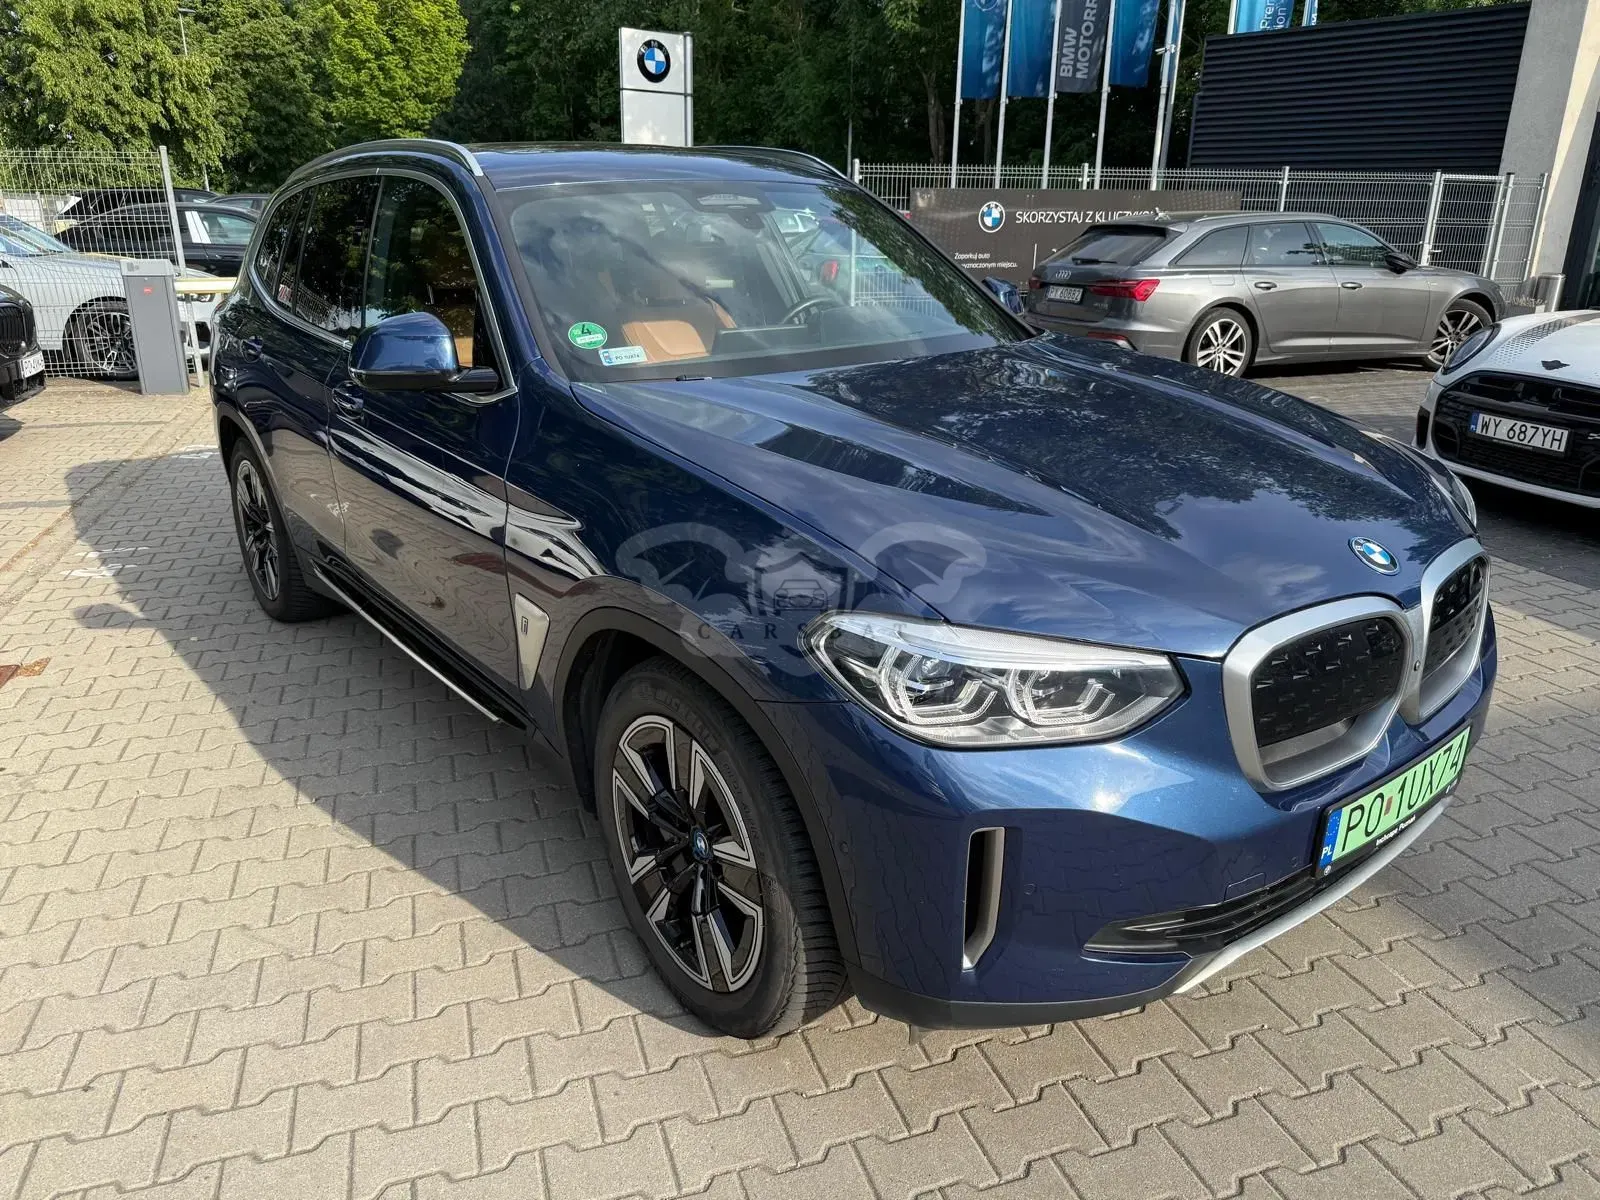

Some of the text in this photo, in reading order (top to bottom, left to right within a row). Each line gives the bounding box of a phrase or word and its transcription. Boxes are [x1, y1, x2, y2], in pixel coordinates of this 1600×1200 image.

[1060, 28, 1077, 77] BMW
[1015, 211, 1083, 224] SKORZYSTAJ
[1085, 211, 1094, 223] Z
[581, 324, 592, 335] 4
[1481, 416, 1502, 437] WY
[1506, 422, 1564, 450] 687YH
[1321, 734, 1466, 859] PL PO 1UX74
